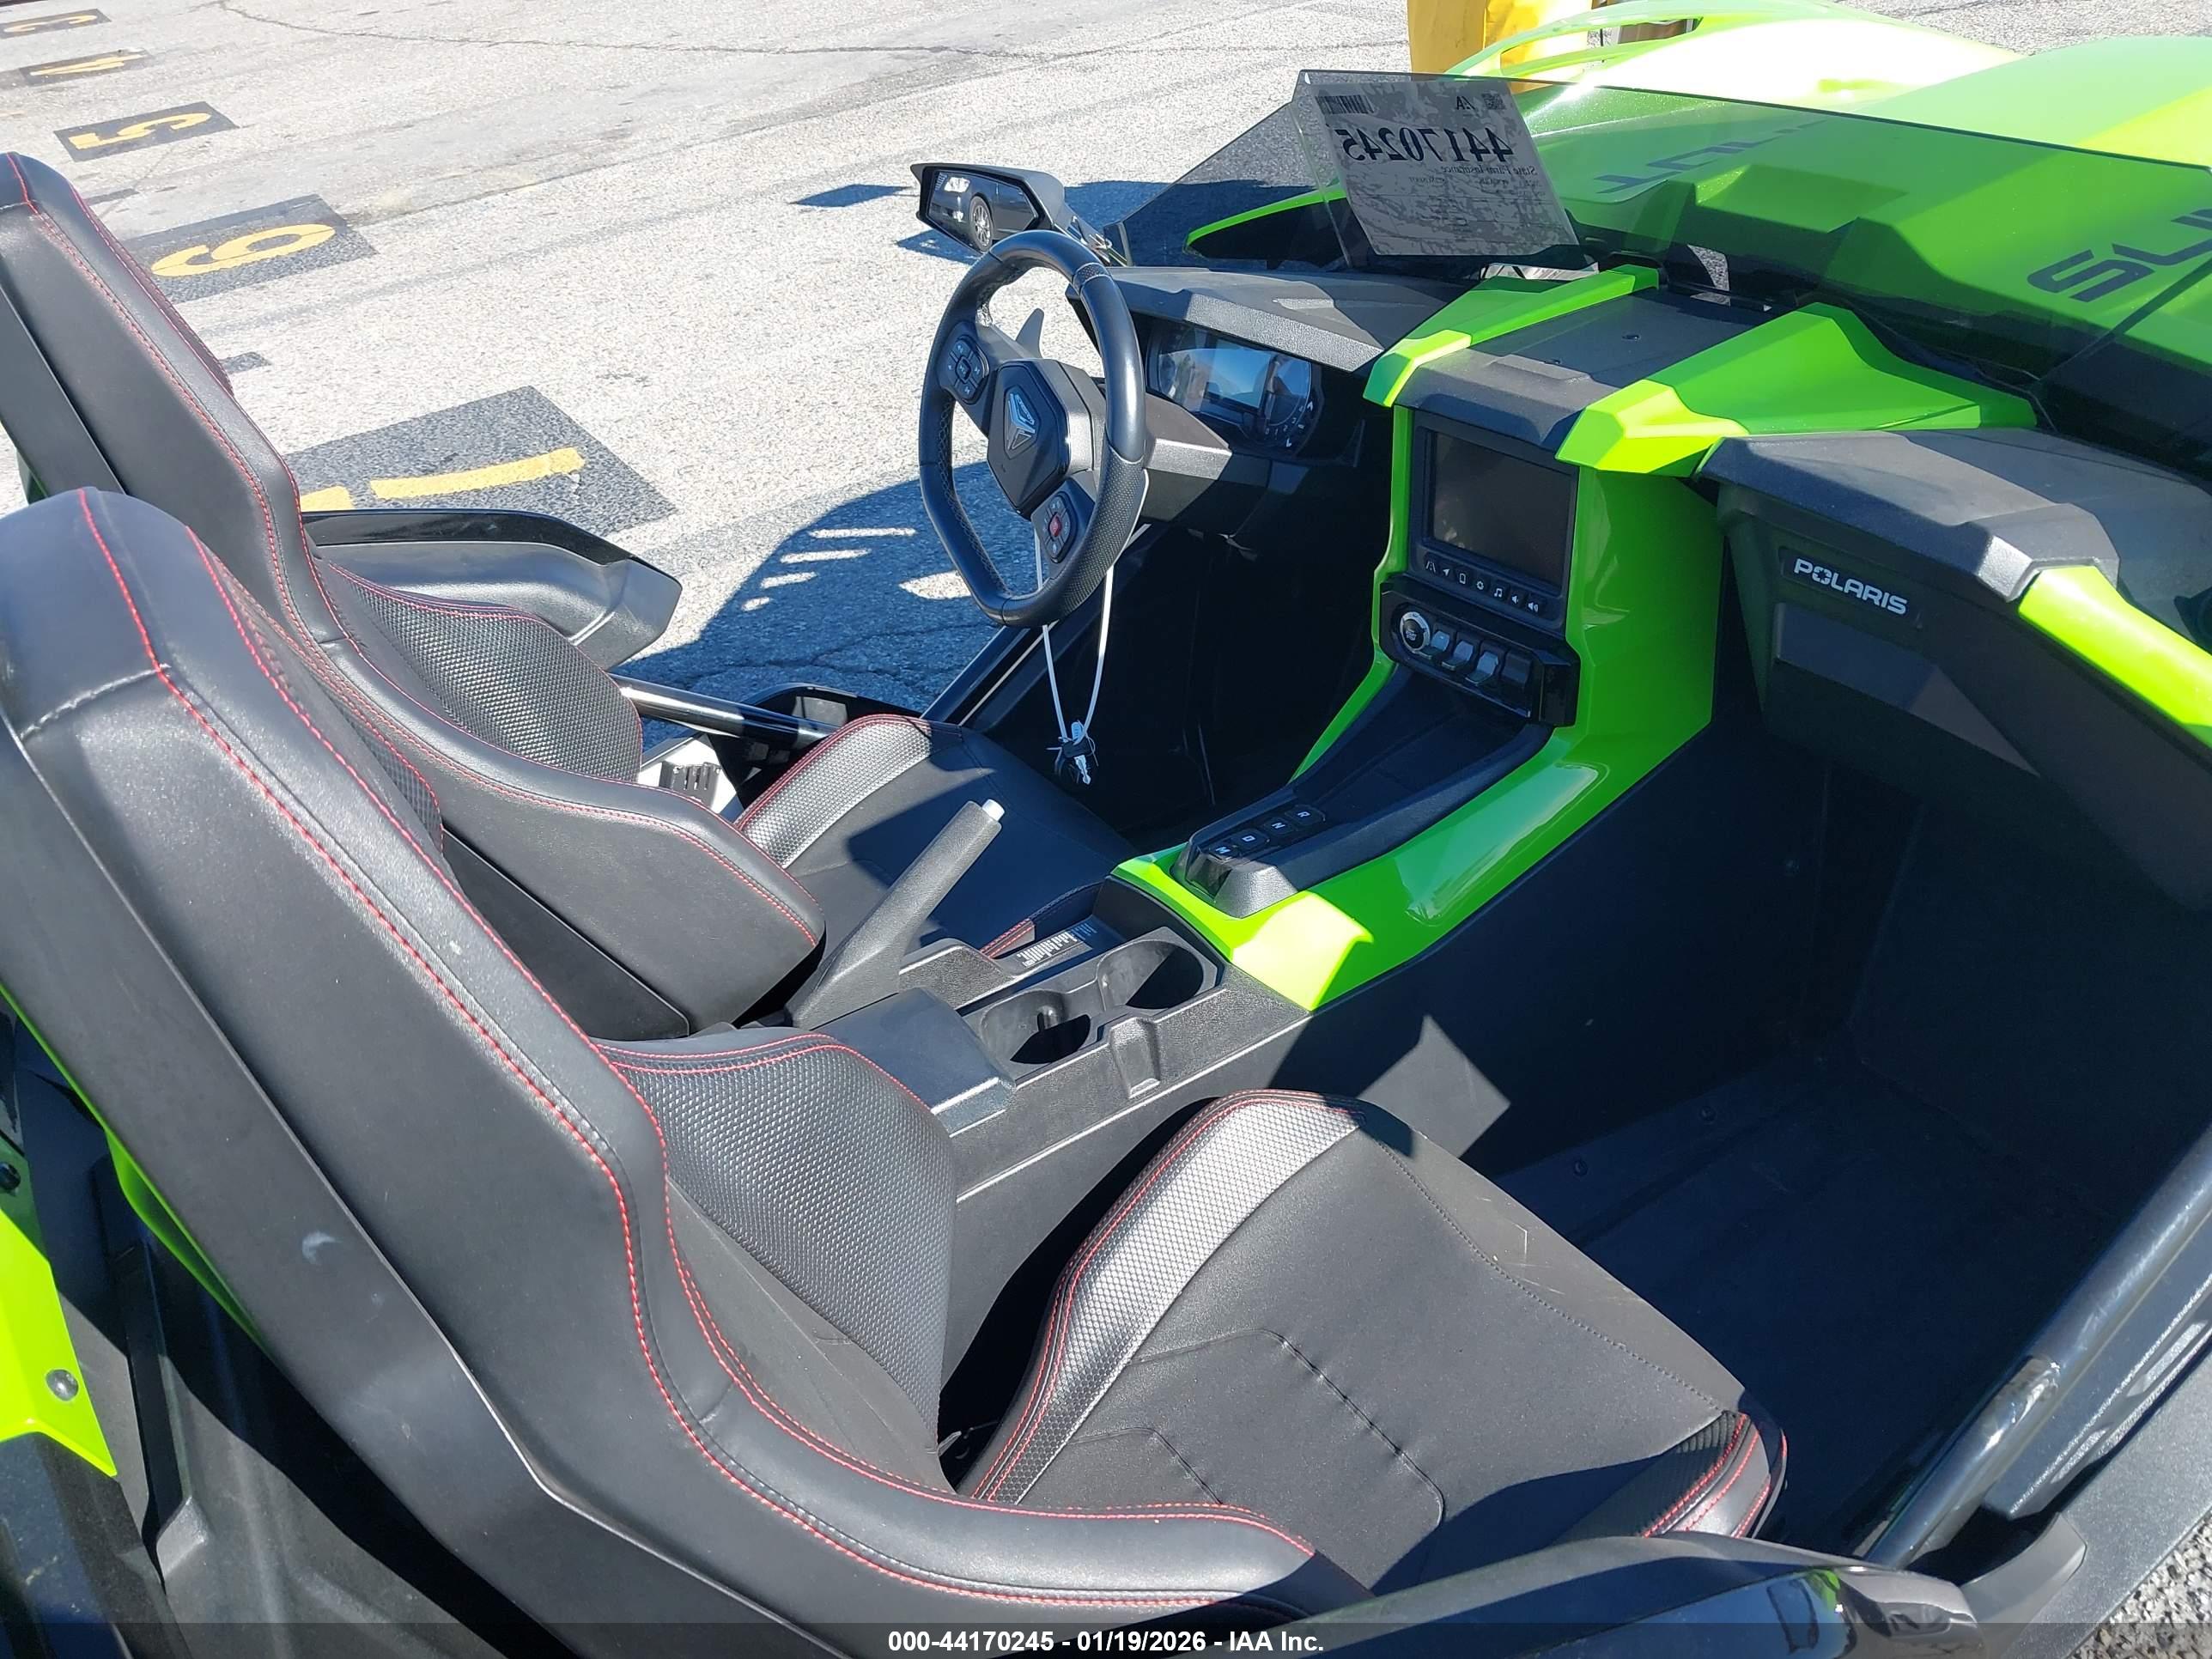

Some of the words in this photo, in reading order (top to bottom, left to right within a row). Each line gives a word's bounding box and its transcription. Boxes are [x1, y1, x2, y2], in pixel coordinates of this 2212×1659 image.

[68, 112, 212, 149] 5
[150, 223, 337, 277] 6
[1793, 557, 1908, 615] POLARIS
